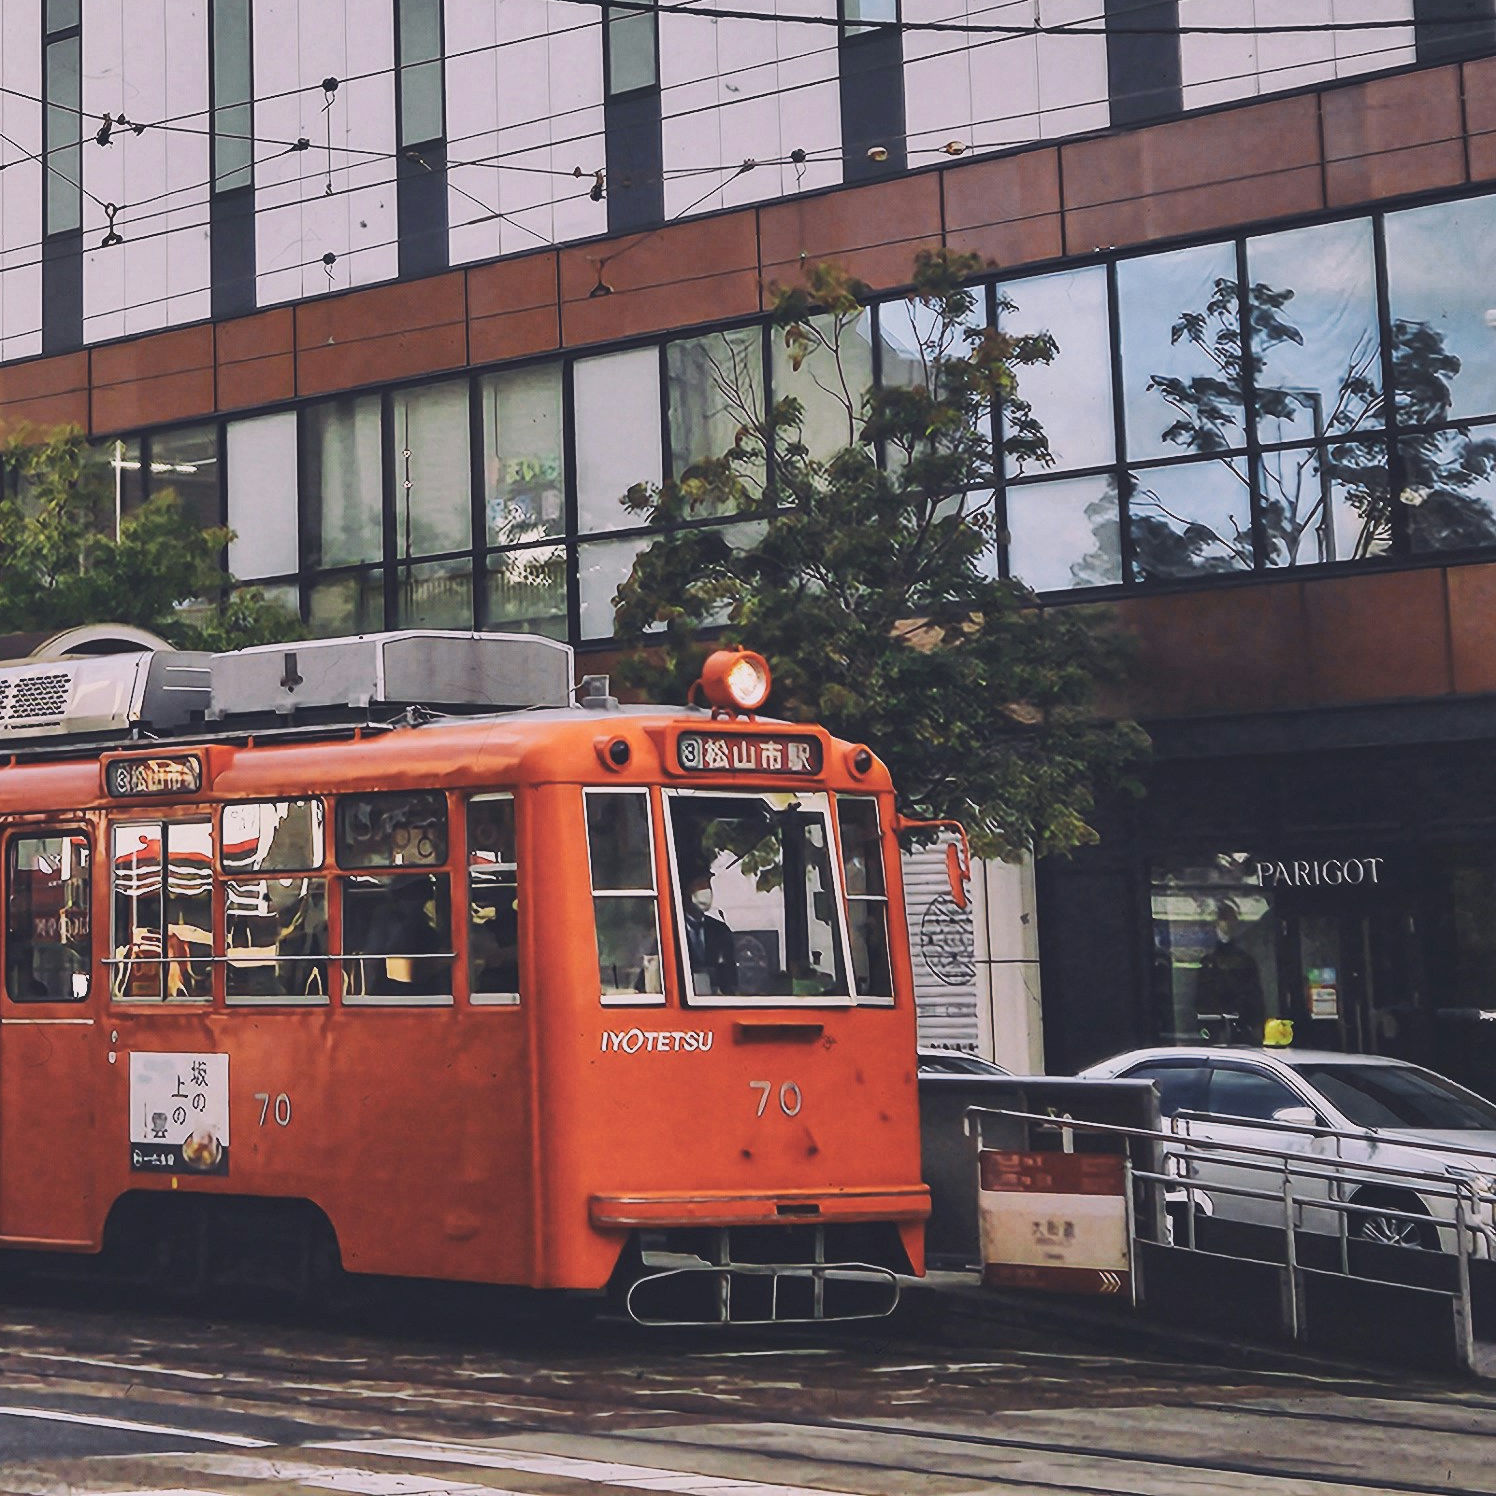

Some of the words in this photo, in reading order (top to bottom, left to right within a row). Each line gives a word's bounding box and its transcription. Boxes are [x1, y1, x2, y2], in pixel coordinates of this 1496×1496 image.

[704, 737, 812, 772] 松山市駅
[1256, 857, 1385, 887] PARIGOT
[600, 1027, 714, 1054] IYOTETSU
[254, 1092, 292, 1127] 70
[749, 1080, 802, 1117] 70
